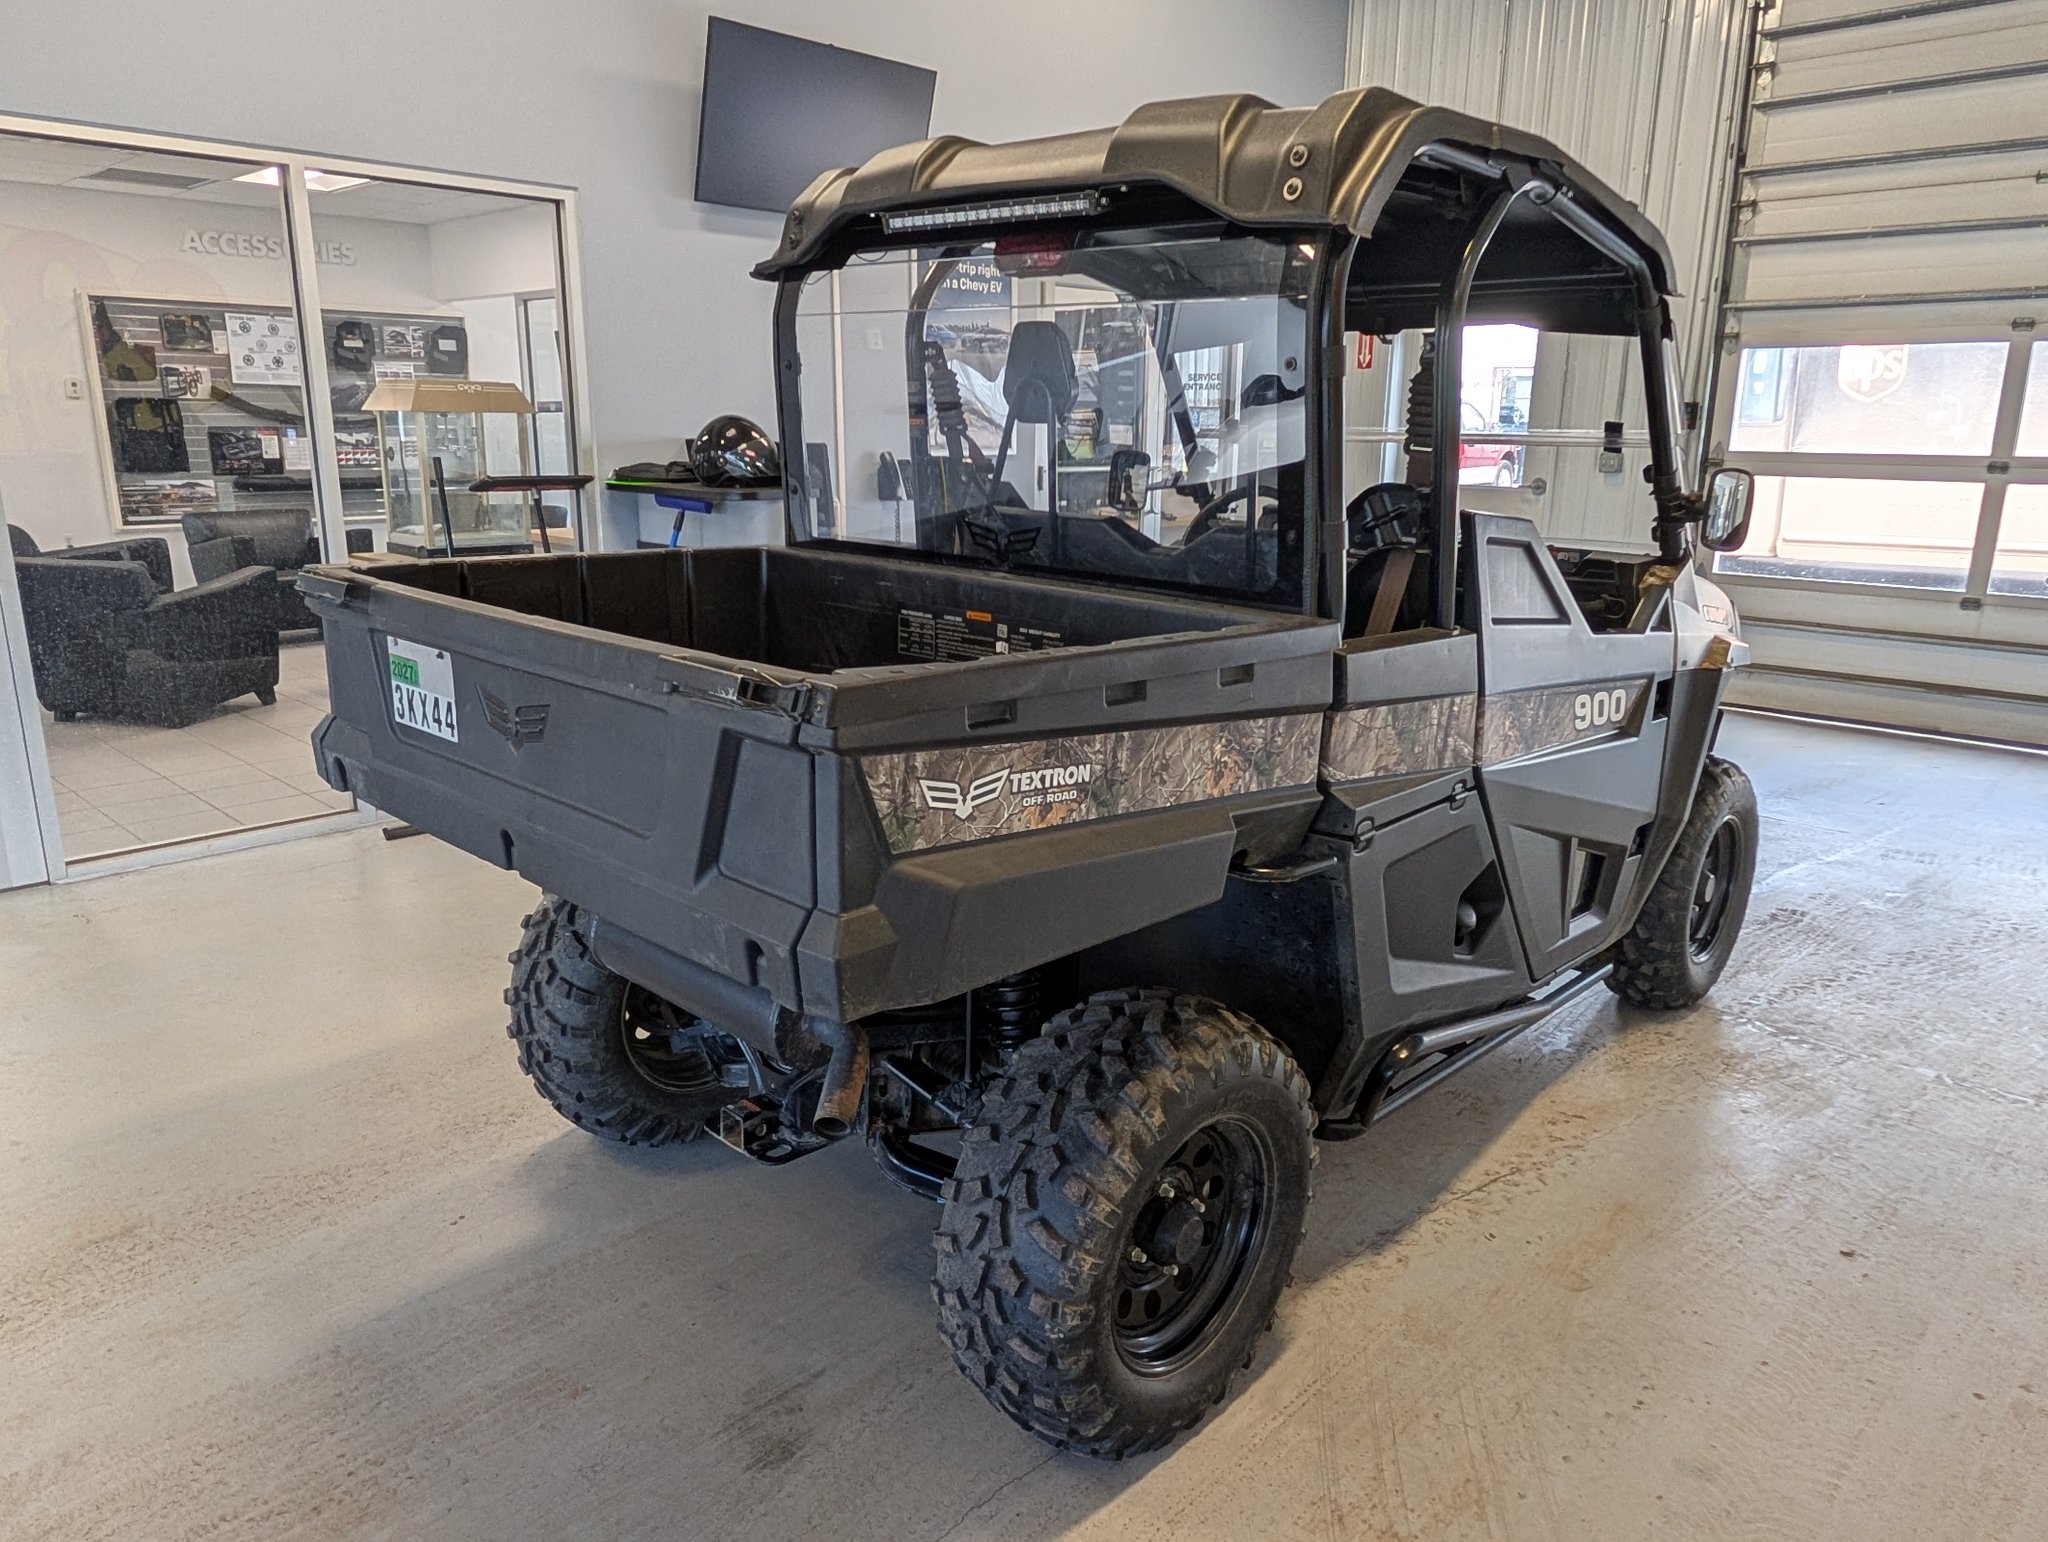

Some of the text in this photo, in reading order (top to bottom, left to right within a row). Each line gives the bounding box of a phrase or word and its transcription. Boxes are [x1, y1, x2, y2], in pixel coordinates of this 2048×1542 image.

[181, 229, 357, 266] ACCESSIES
[960, 278, 989, 294] Chevy
[990, 282, 1003, 293] EV
[1184, 382, 1222, 391] ENTRANC
[1188, 373, 1222, 382] SERVICE
[391, 660, 414, 682] 2027
[395, 683, 455, 738] 3KX44
[1574, 688, 1627, 730] 900
[1010, 763, 1091, 793] TEXTRON
[1022, 790, 1077, 807] OFF ROAD
